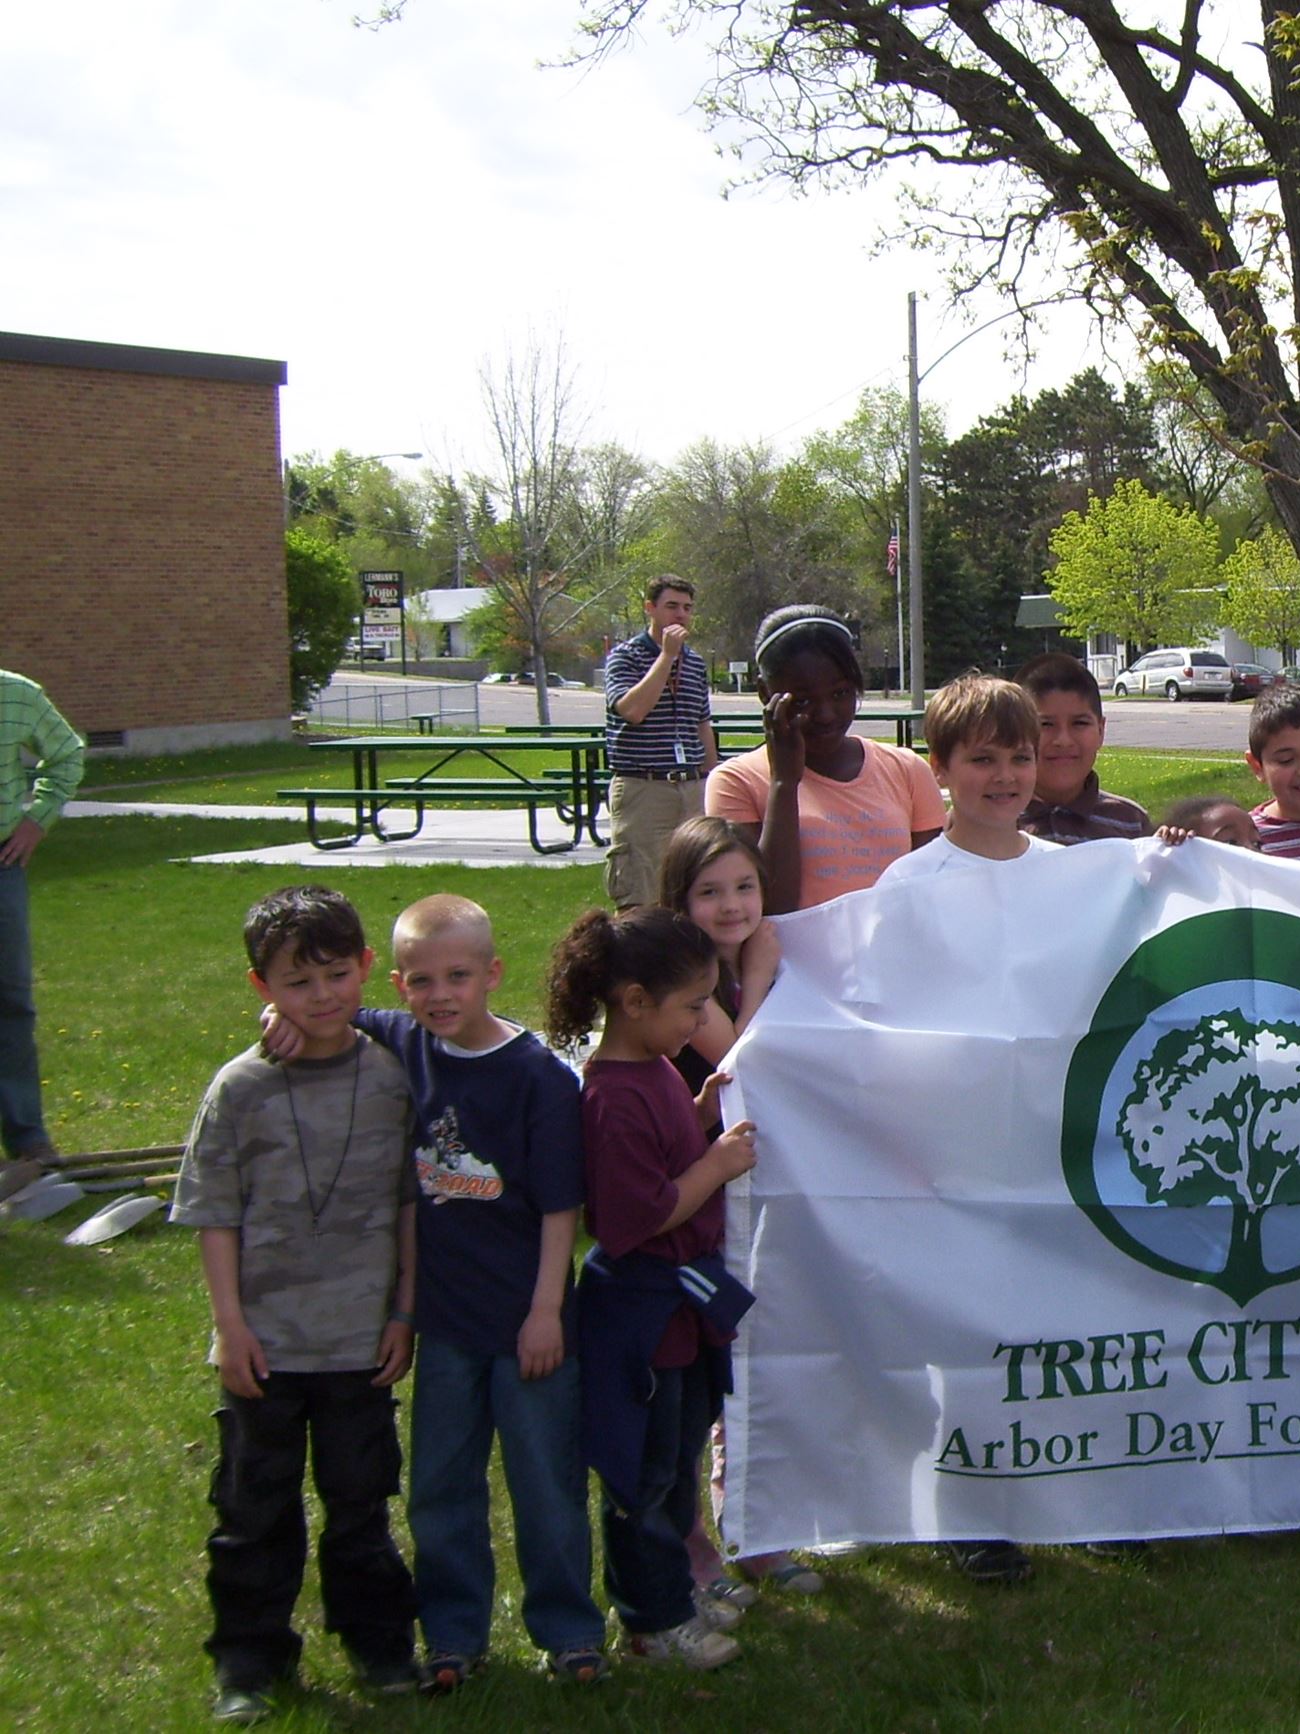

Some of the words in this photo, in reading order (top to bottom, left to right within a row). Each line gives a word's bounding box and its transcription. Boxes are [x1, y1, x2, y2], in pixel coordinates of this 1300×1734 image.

[367, 587, 398, 598] TORO
[993, 1328, 1169, 1402] TREE
[935, 1420, 1098, 1471] Arbor
[1125, 1410, 1225, 1463] Day
